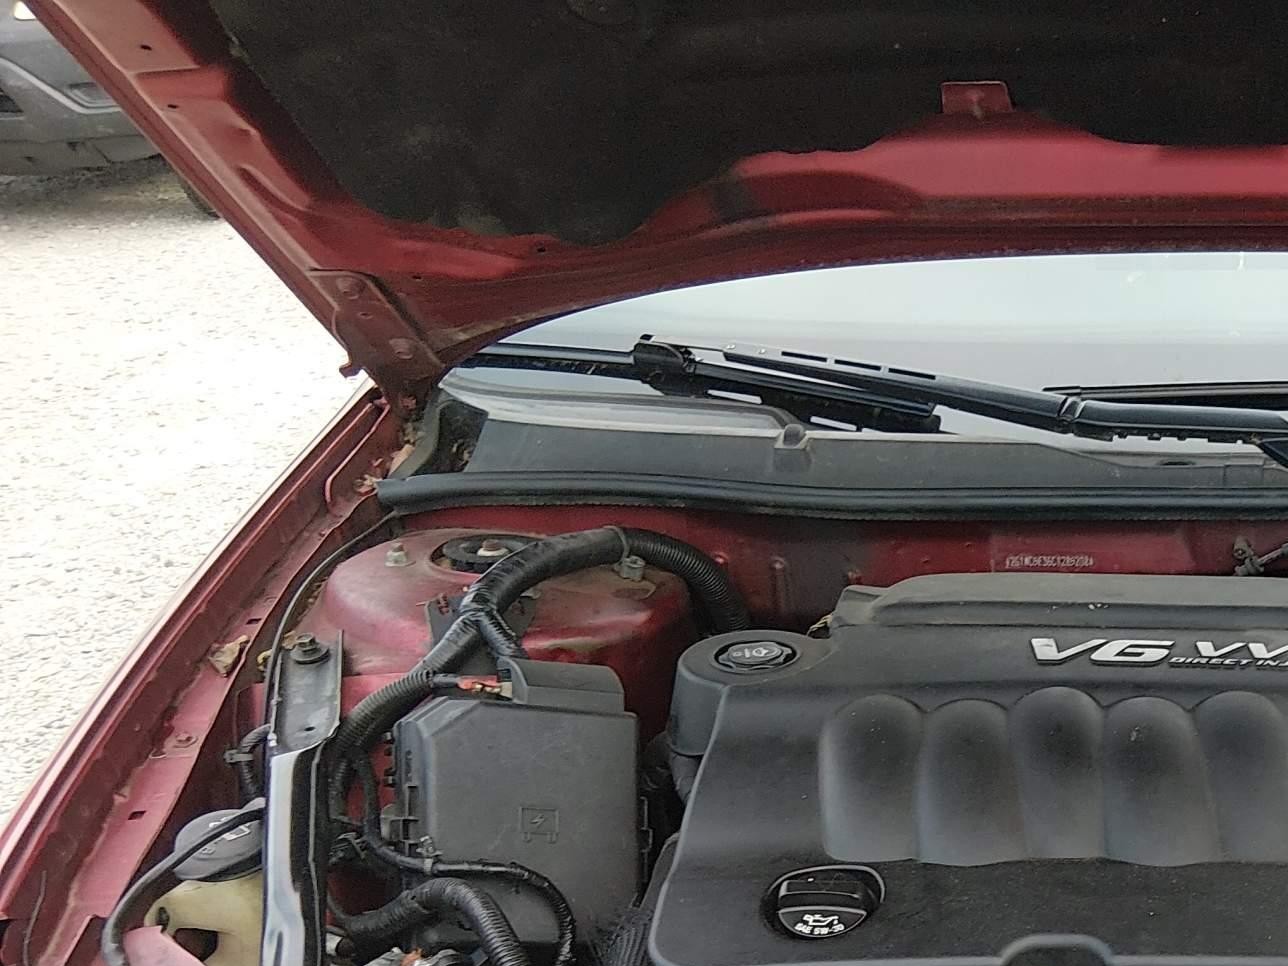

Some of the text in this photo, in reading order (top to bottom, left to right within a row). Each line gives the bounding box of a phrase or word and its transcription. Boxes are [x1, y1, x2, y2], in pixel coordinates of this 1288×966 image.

[1031, 638, 1175, 663] V6
[1169, 656, 1252, 666] DIRECT
[794, 922, 813, 934] SAE
